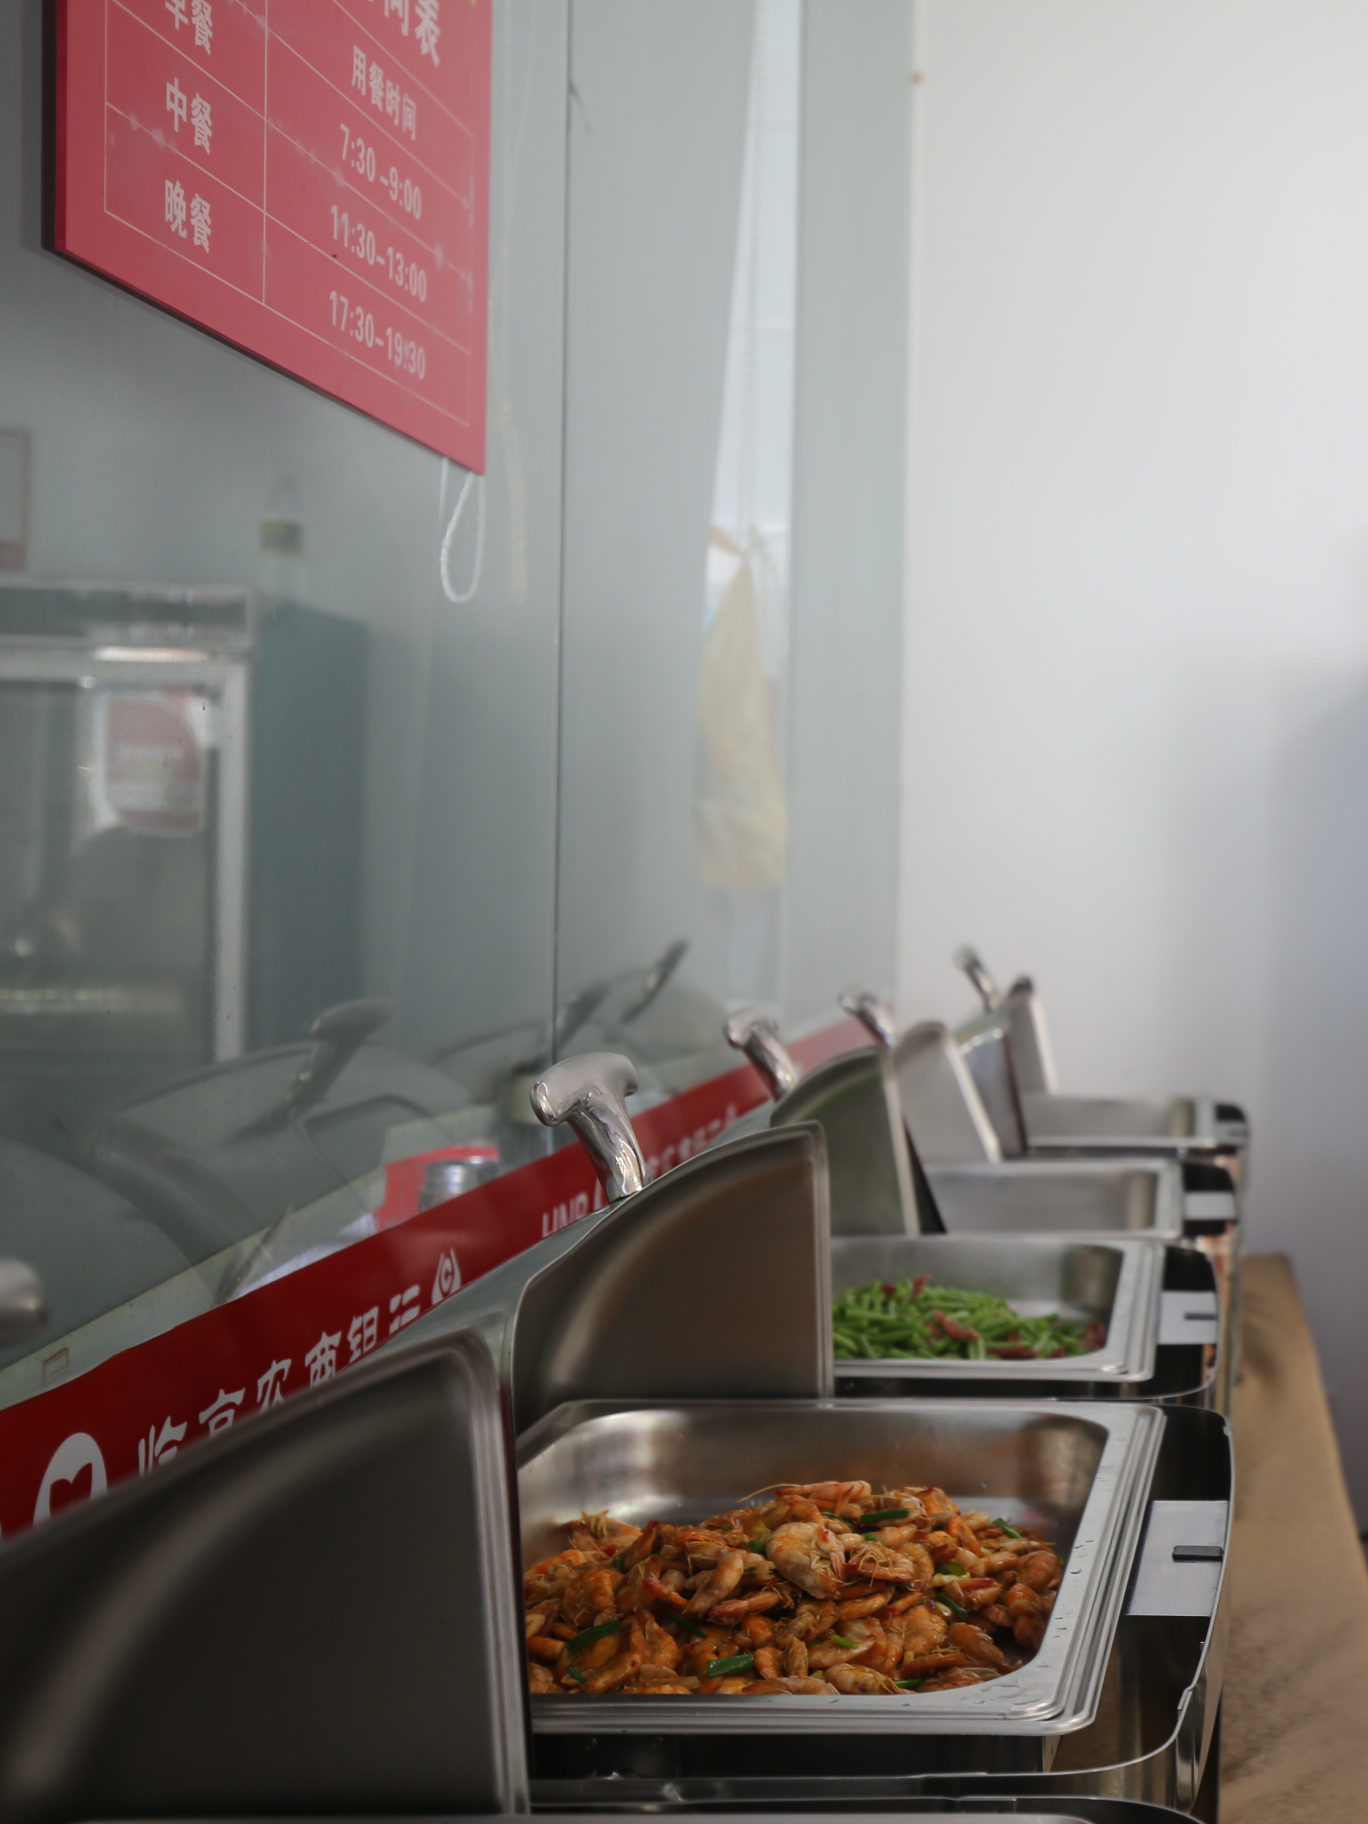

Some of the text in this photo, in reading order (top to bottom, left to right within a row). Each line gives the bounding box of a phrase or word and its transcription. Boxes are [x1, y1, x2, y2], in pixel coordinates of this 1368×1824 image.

[165, 77, 213, 154] 中餐
[352, 44, 417, 141] 用餐时间
[164, 179, 212, 253] 晚餐
[331, 205, 427, 303] 11:30-13:00
[330, 290, 426, 380] 17:30-19:30
